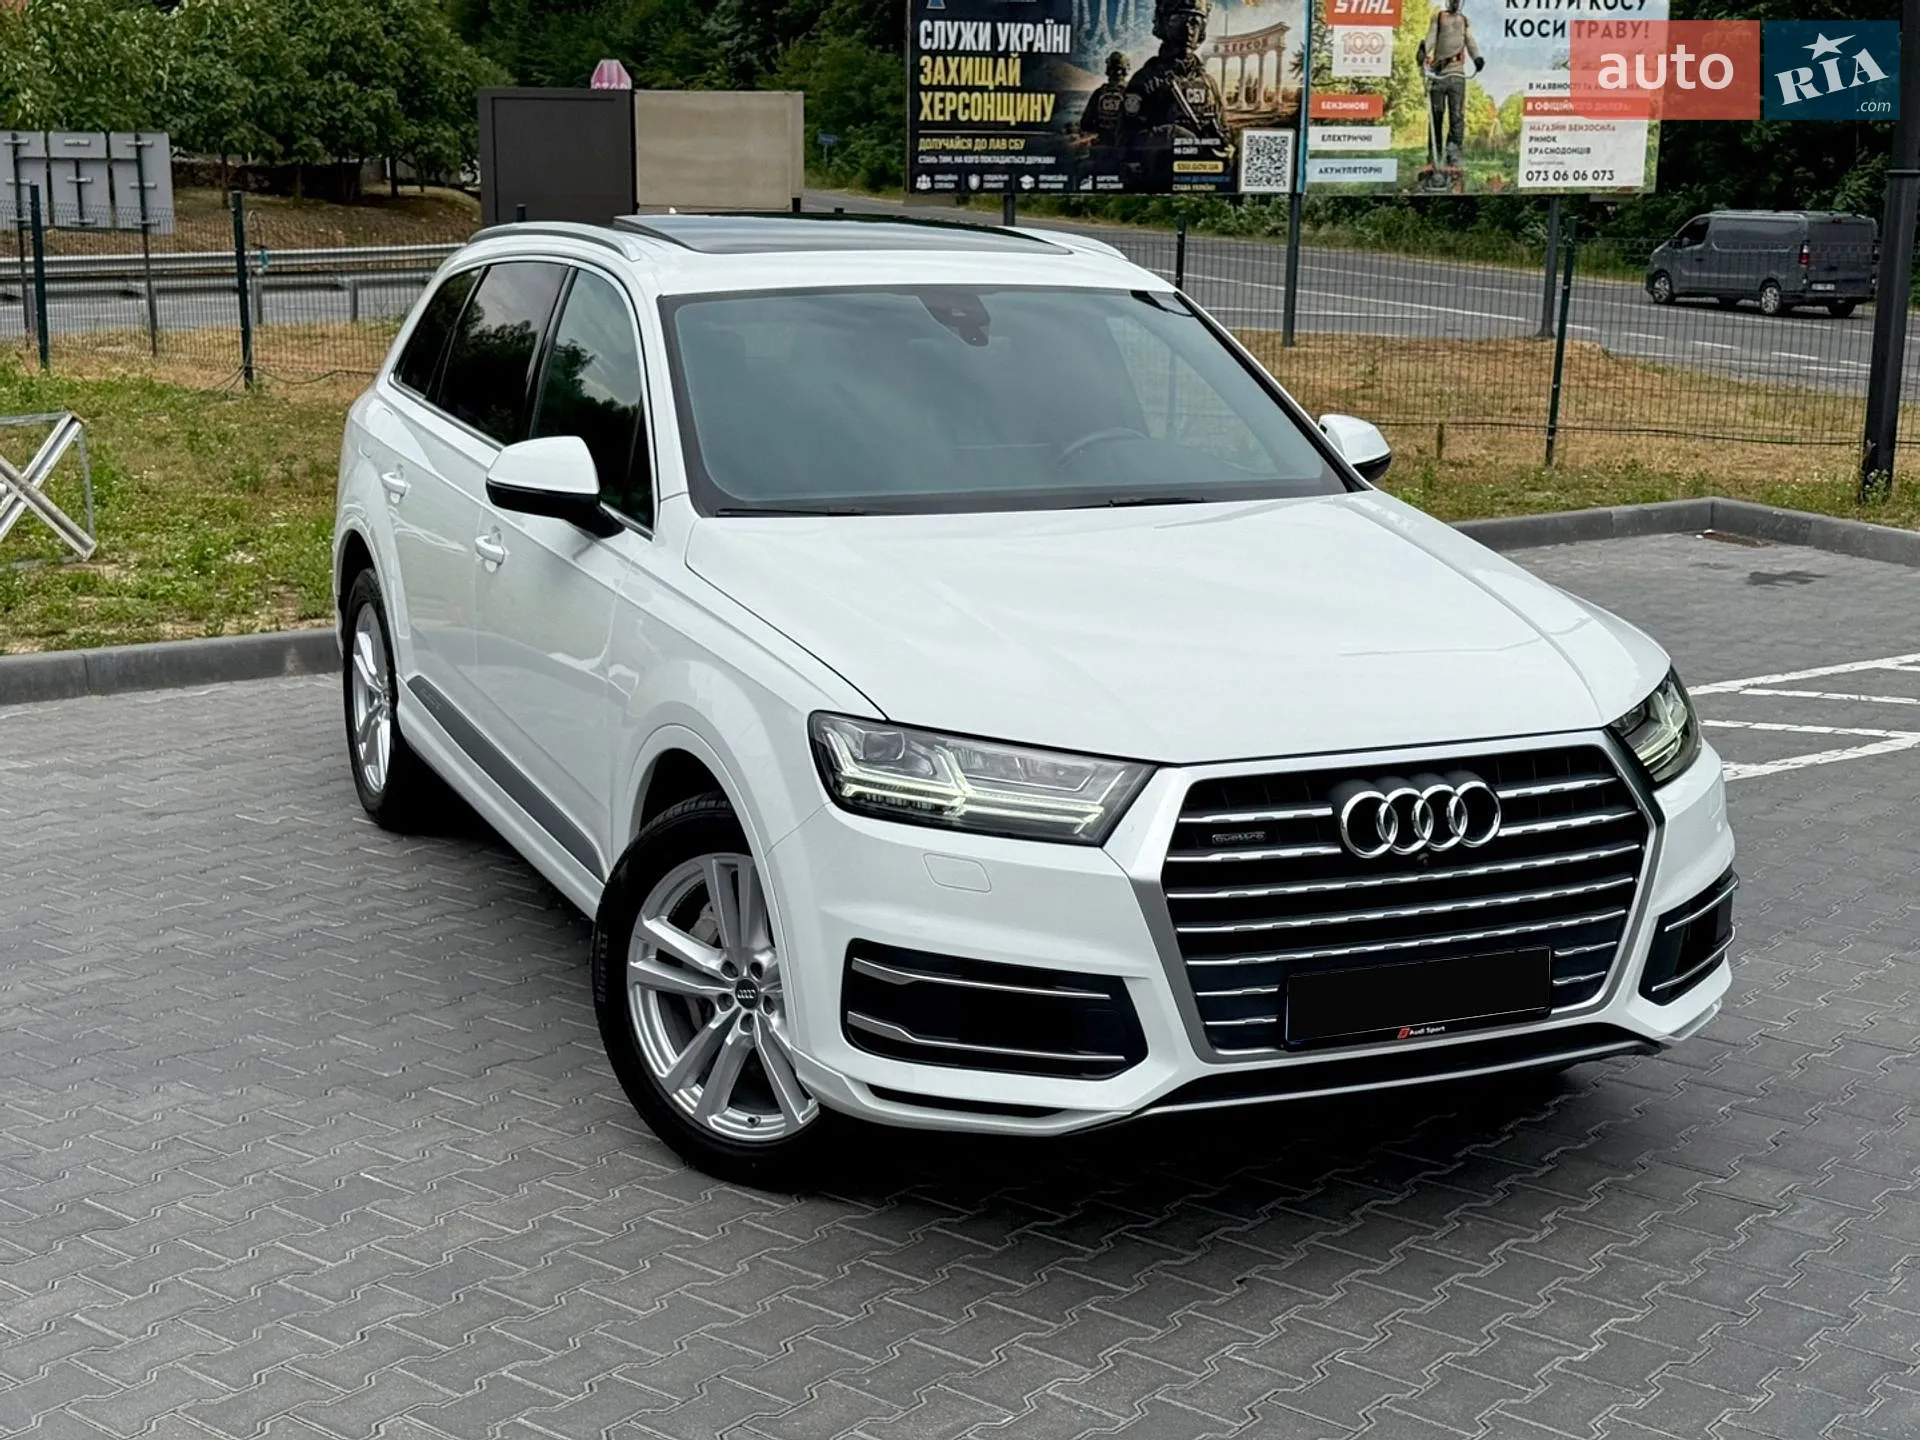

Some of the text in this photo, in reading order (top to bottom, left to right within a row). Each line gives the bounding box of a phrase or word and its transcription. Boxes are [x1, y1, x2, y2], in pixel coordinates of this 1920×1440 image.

[1334, 0, 1395, 14] STIHL
[1504, 19, 1649, 39] КОСИ ТРАВУ!
[919, 18, 1071, 54] СЛУЖИ УКРАЇНІ
[1342, 32, 1385, 55] 100
[1343, 56, 1382, 64] РОКІВ
[919, 53, 1021, 90] ЗАХИЩАЙ
[1186, 87, 1206, 104] СБУ
[919, 91, 1056, 126] ХЕРСОНЩИНУ
[1321, 100, 1369, 111] БЕНЗИНОВІ
[1529, 123, 1616, 132] МАГАЗИН БЕНЗОСИЛА
[1321, 131, 1373, 143] ЕЛЕКТРИЧНІ
[1529, 135, 1557, 143] РИНОК
[918, 136, 1026, 151] ДОЛУЧАЙСЯ ДО ЛАВ СБУ
[1528, 147, 1591, 155] КРАСНОДОНЦІВ
[1318, 166, 1383, 175] АКУМУЛЯТОРНІ
[1526, 170, 1615, 182] 073 06 06 073
[1409, 1025, 1446, 1035] Audi Sport
